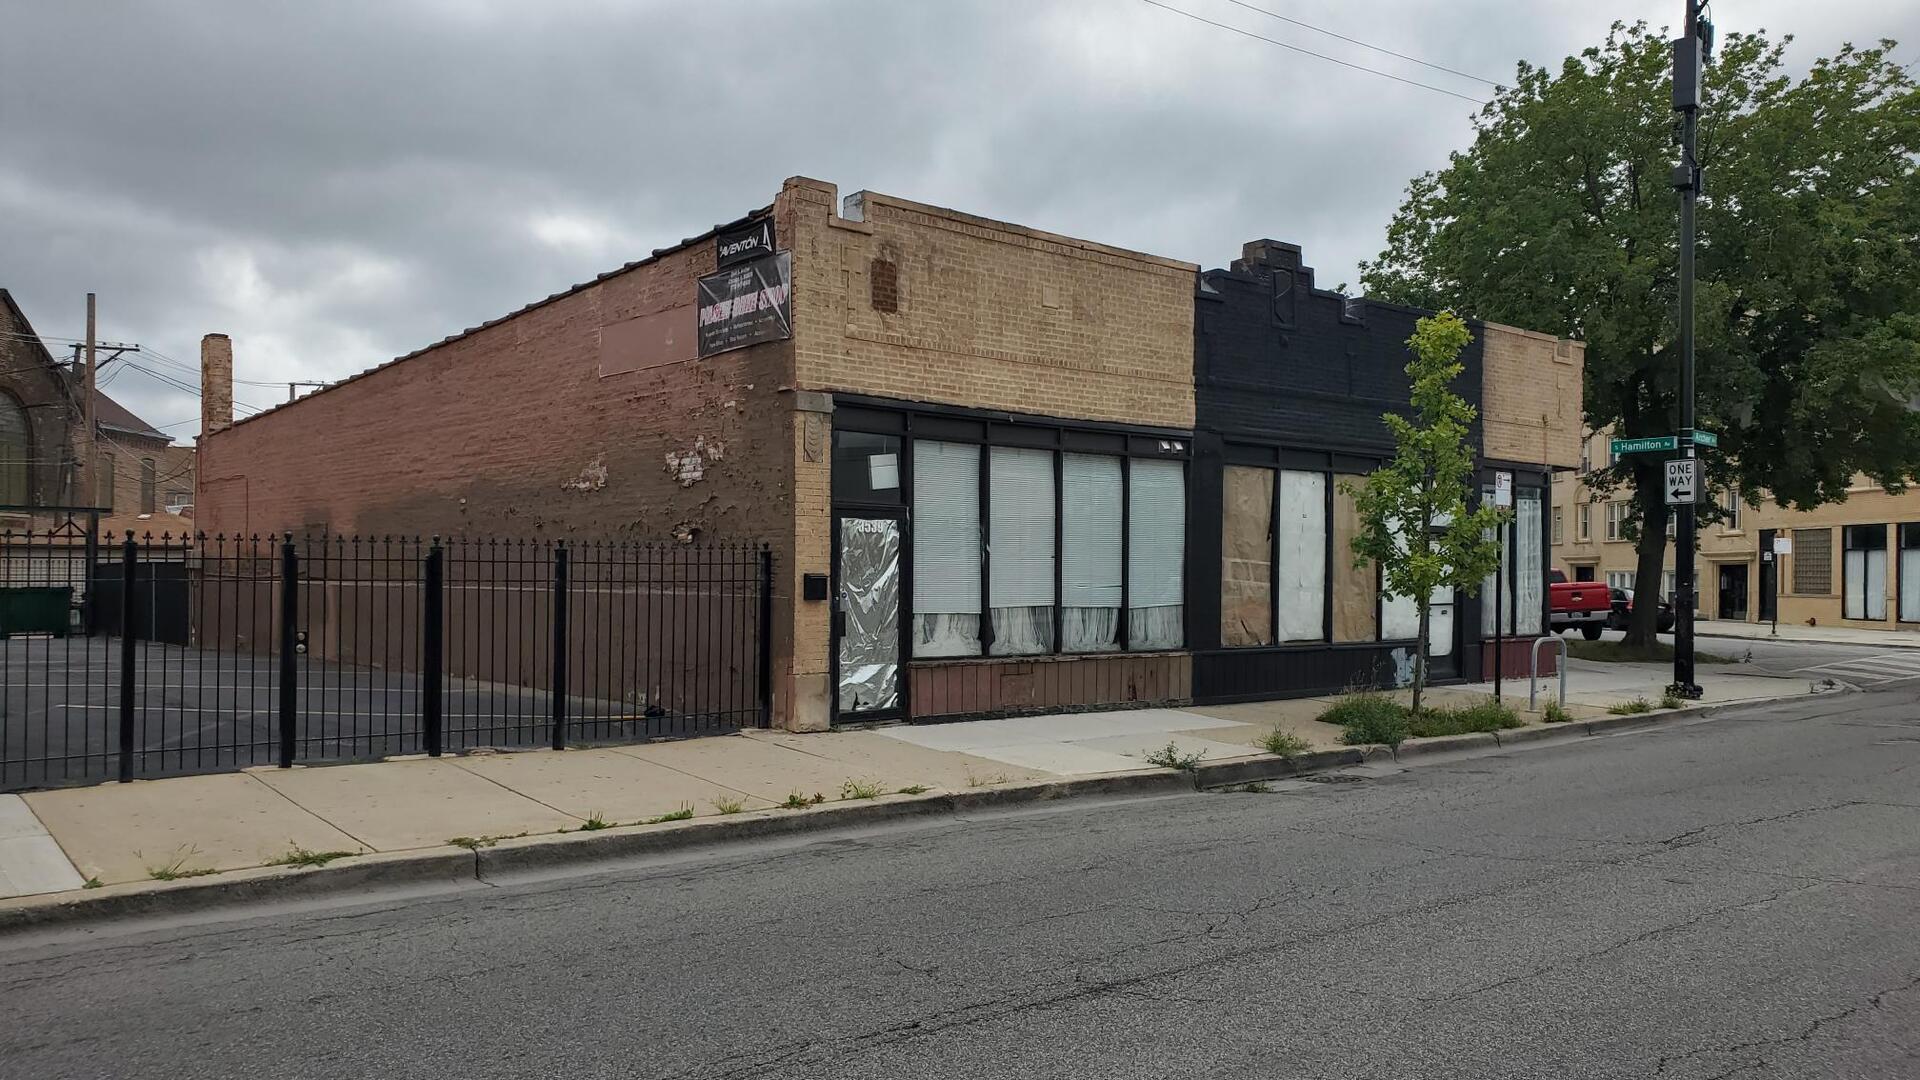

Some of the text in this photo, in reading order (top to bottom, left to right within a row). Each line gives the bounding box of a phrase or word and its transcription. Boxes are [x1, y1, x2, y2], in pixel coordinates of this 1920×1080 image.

[1621, 441, 1661, 451] Hamilton
[1669, 464, 1692, 475] ONE
[1669, 475, 1692, 486] WAY
